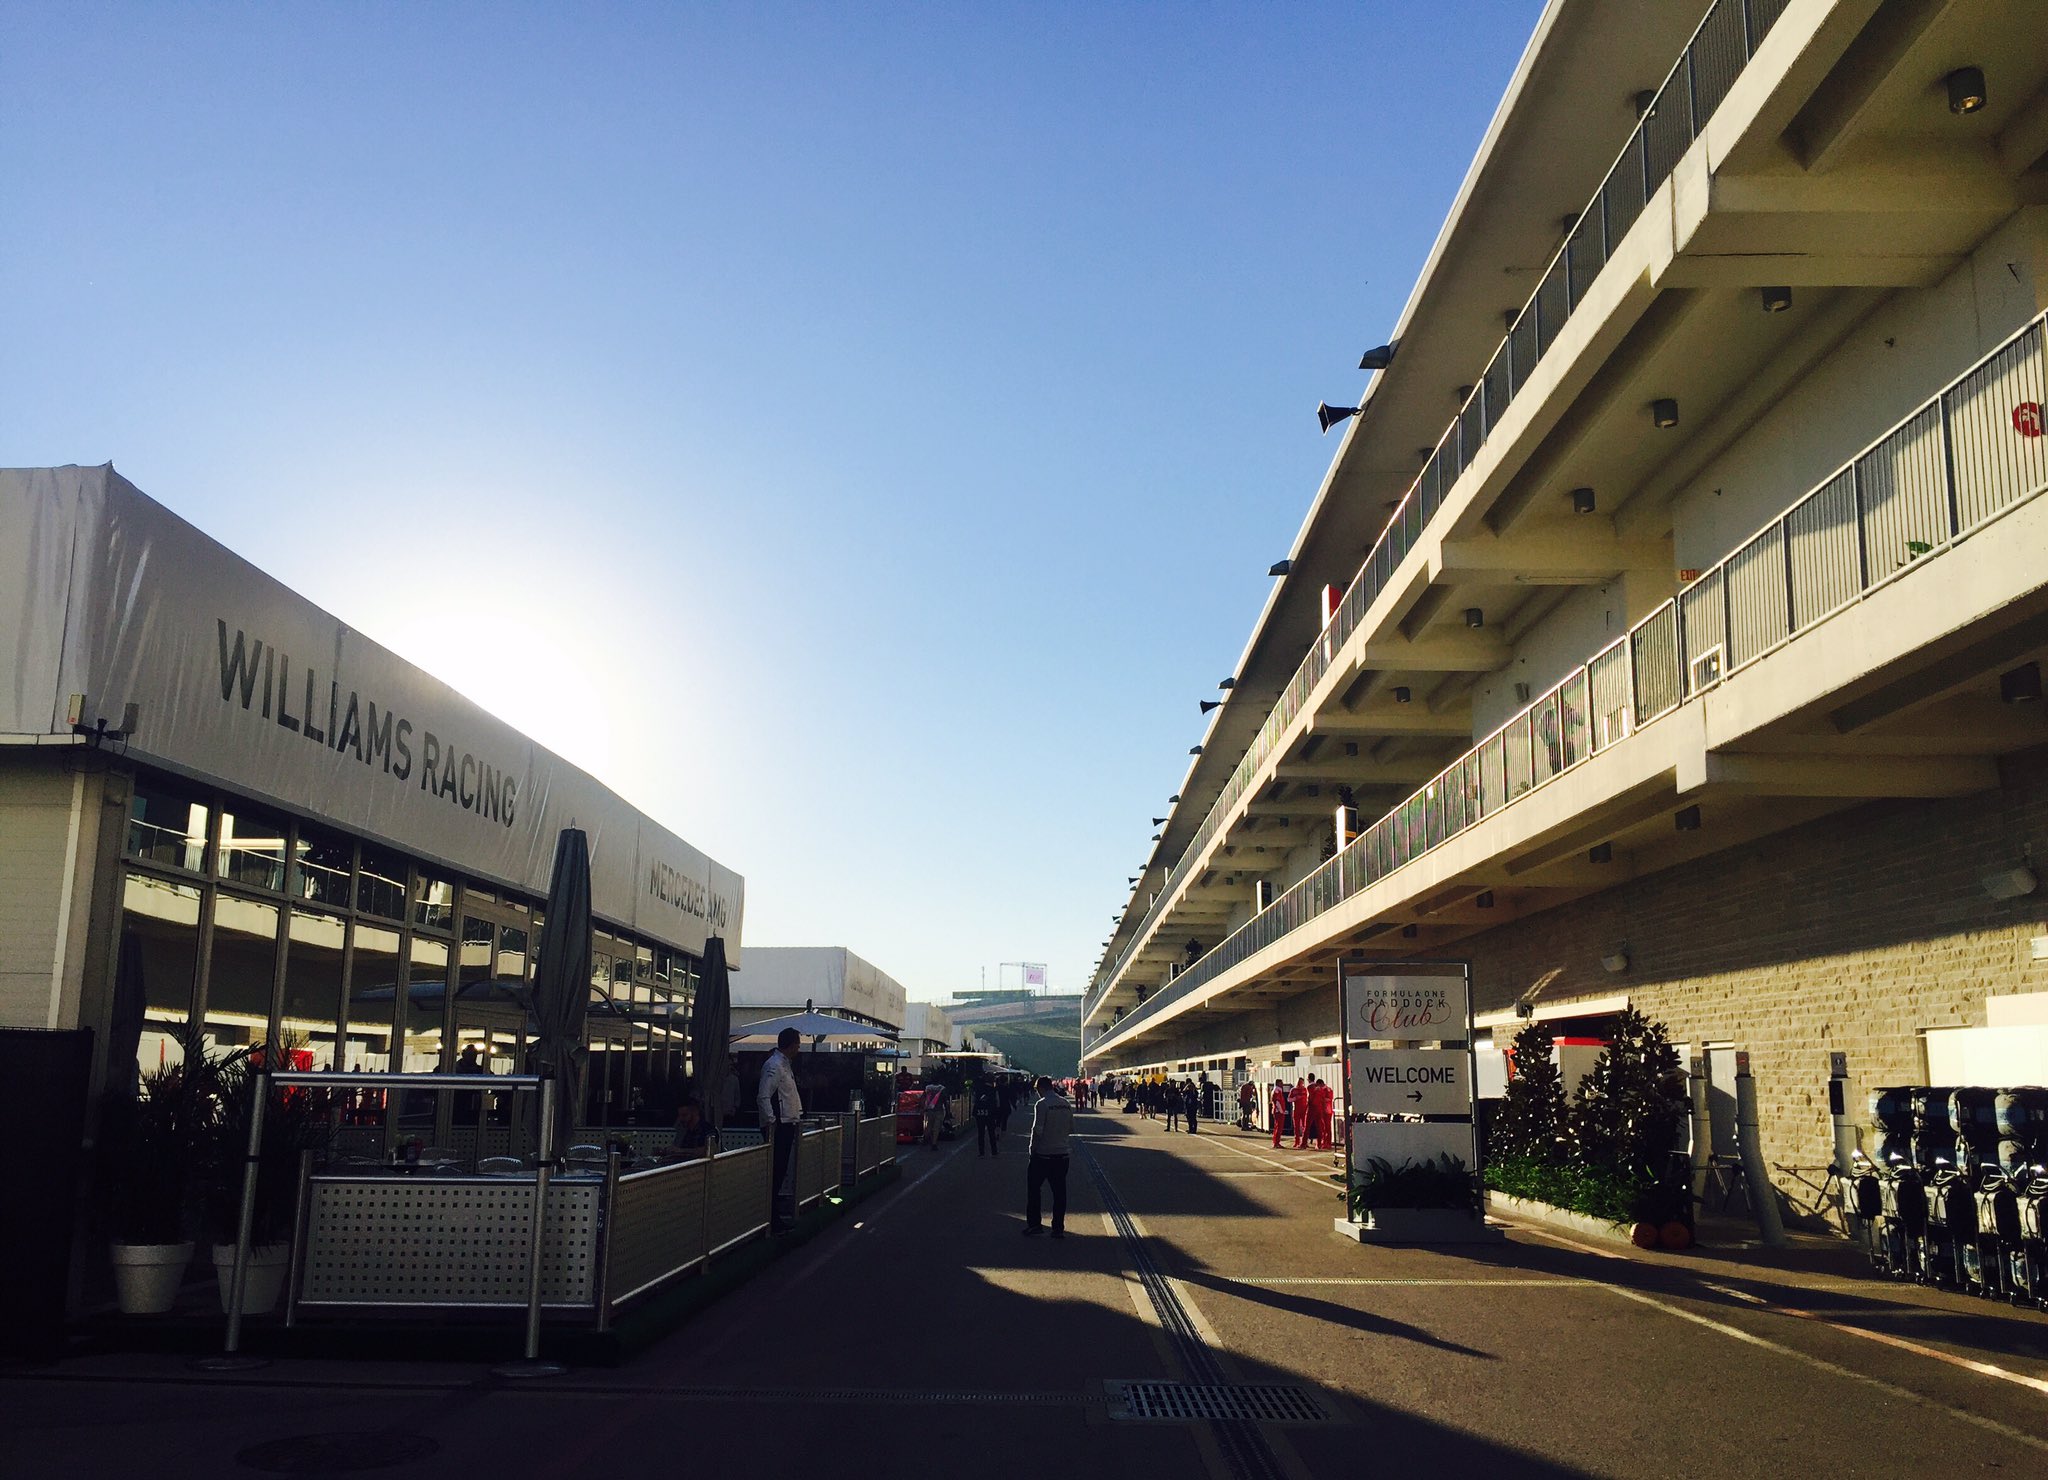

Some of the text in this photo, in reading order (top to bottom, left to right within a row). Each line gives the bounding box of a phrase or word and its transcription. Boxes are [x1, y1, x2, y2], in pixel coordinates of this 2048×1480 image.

[217, 618, 516, 828] WILLIAMS RACING
[650, 859, 726, 928] MERCEDES AMG
[1360, 1000, 1452, 1032] Club
[1366, 998, 1446, 1008] PADDOCK
[1366, 1067, 1455, 1083] WELCOME
